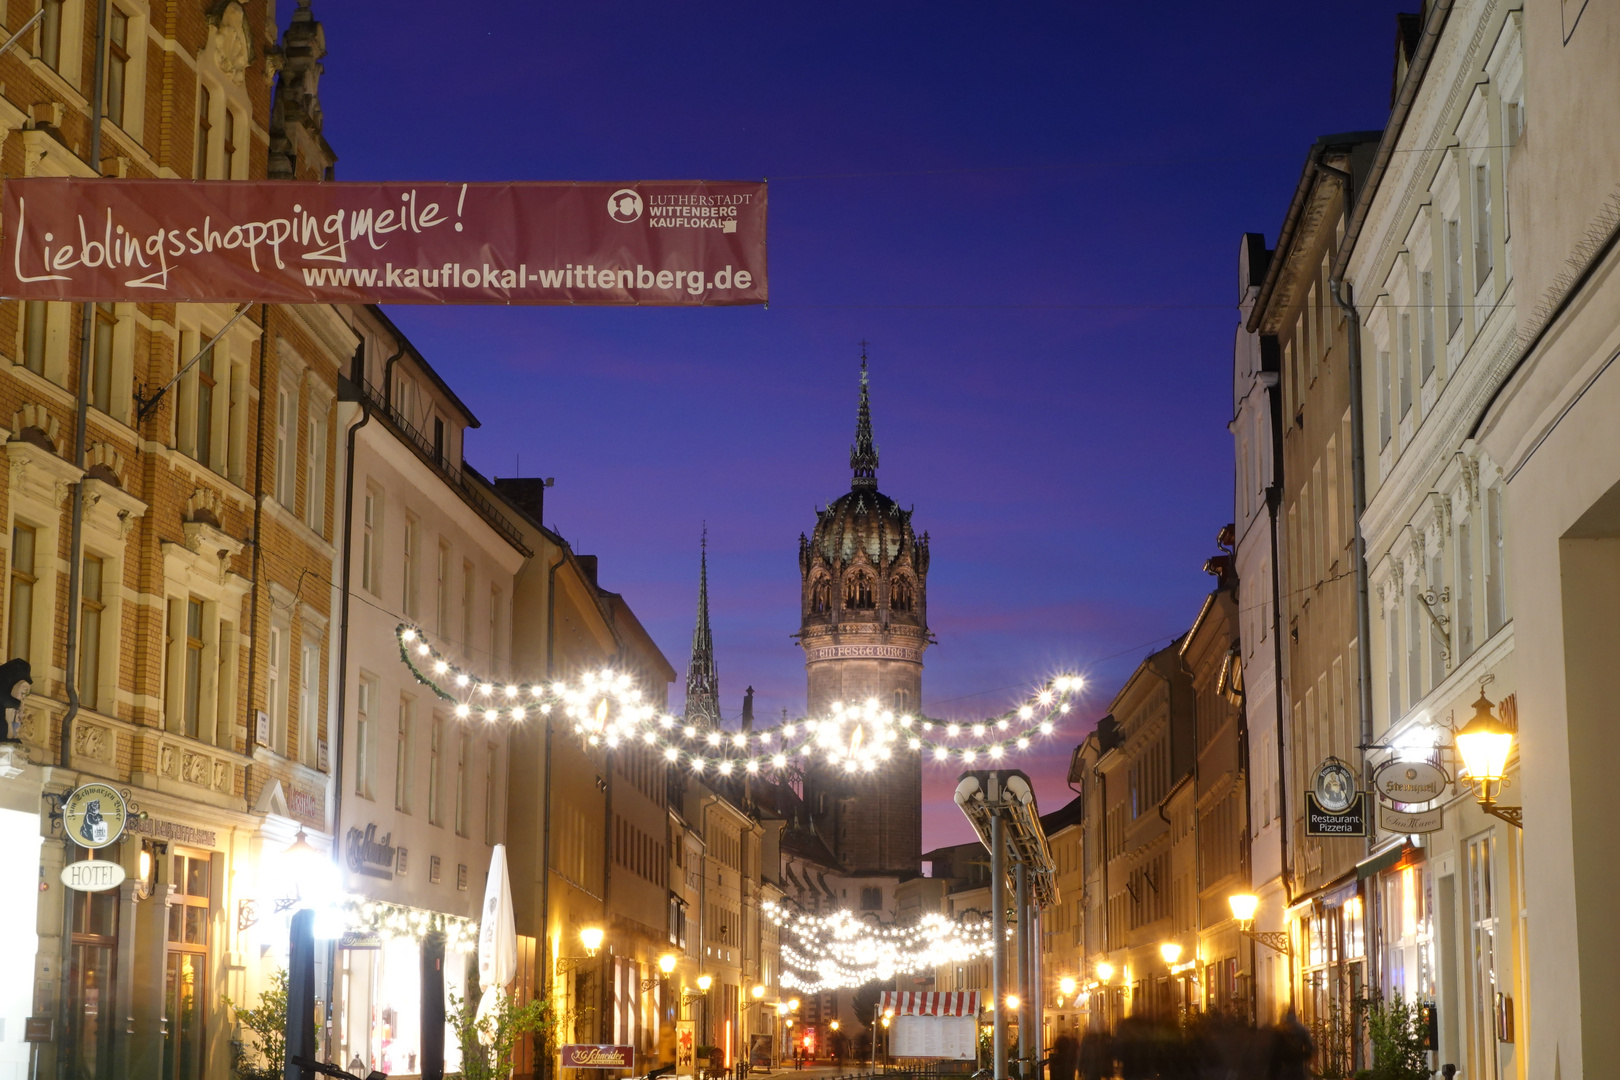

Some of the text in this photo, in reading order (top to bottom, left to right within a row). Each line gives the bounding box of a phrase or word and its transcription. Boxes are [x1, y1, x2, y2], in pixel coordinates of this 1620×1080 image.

[649, 194, 753, 206] LUTHERSTADT
[649, 206, 738, 217] WITTENBERG
[649, 217, 726, 228] KAUFLOKAL
[302, 263, 752, 295] www.kauflokal-wittenberg.de
[838, 646, 874, 657] FESTE
[876, 646, 903, 657] BURG
[1385, 780, 1437, 794] Sternquell
[66, 801, 77, 821] Zum
[75, 788, 116, 801] Schwarzen
[1311, 814, 1360, 823] Restaurant
[1385, 815, 1437, 829] San Marco
[1319, 823, 1353, 832] Pizzeria
[70, 866, 116, 886] HOTEL
[578, 1048, 625, 1062] Schneider
